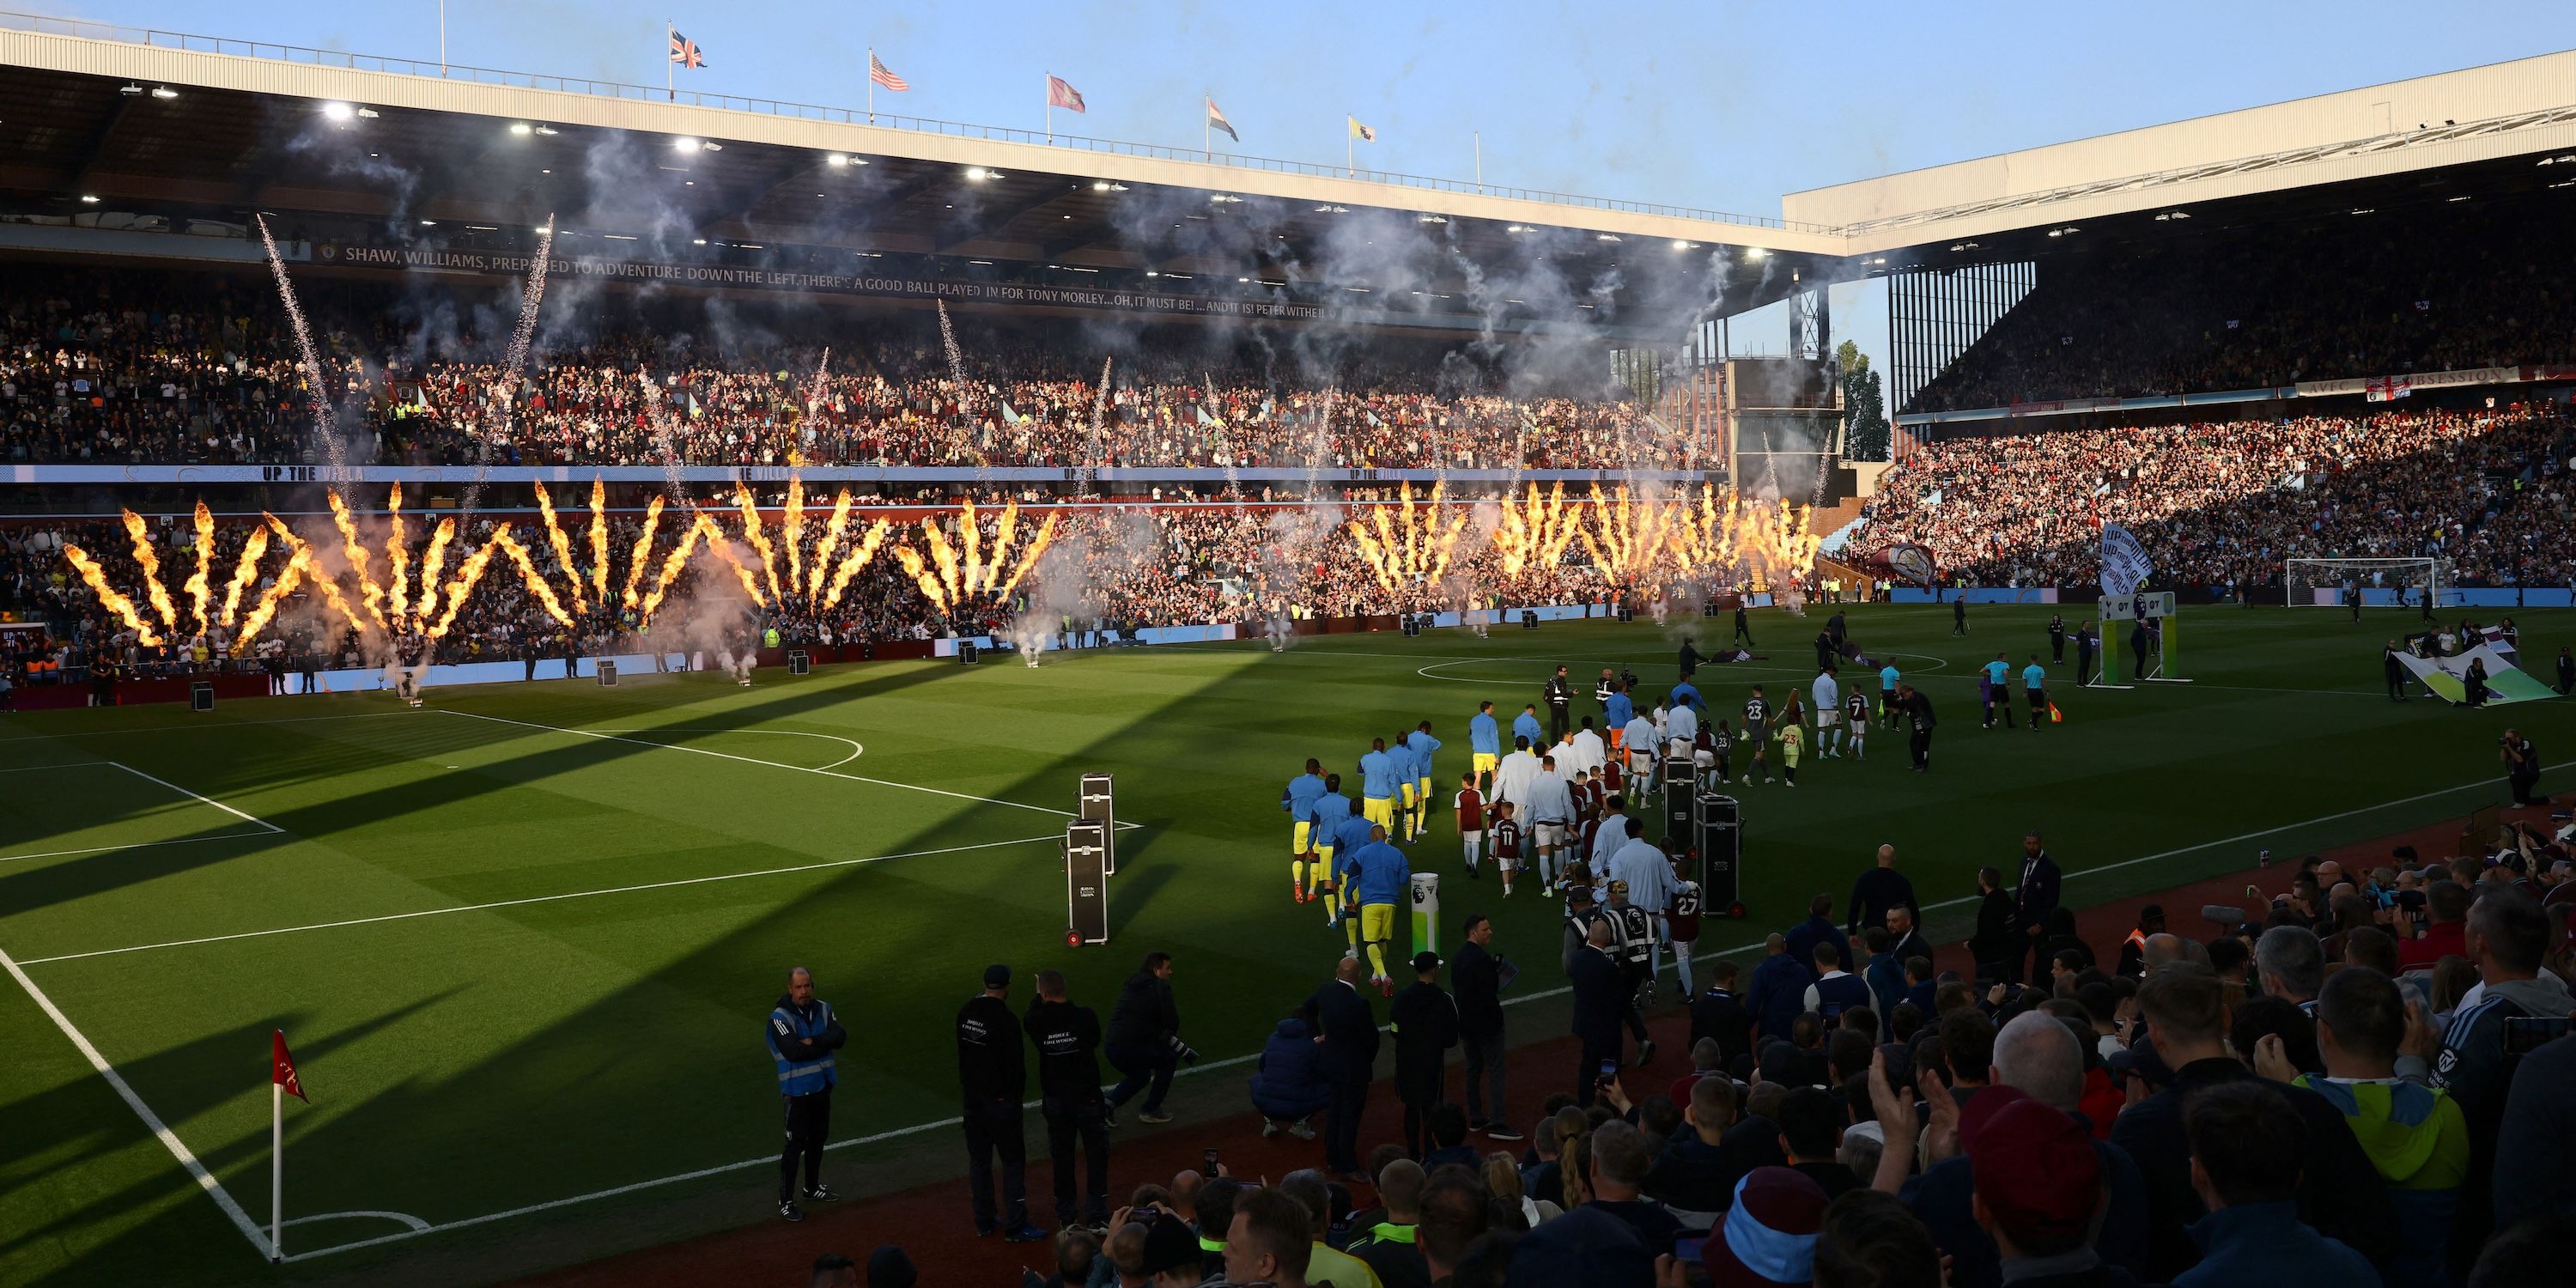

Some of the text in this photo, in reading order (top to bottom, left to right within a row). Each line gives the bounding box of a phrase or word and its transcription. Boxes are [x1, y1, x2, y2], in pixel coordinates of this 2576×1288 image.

[345, 246, 401, 265] SHAW,
[406, 250, 489, 270] WILLIAMS,
[492, 257, 568, 274] PREPED
[573, 261, 592, 275] TO
[596, 262, 682, 279] ADVENTURE
[687, 267, 733, 282] DOWN
[736, 270, 762, 283] THE
[854, 278, 864, 289] A
[865, 278, 902, 291] GOOD
[907, 282, 936, 294] BALL
[938, 283, 981, 296] PLAYED
[987, 286, 998, 297] IN
[1001, 287, 1024, 300] FOR
[1027, 289, 1059, 301] TONY
[1146, 297, 1176, 309] MUST
[1178, 299, 1194, 311] BE!
[1229, 302, 1238, 313] IT
[1256, 304, 1285, 317] PETER
[2310, 381, 2349, 393] AVFC
[263, 466, 282, 481] UP
[289, 466, 316, 481] THE
[1064, 468, 1076, 480] UP
[1350, 470, 1360, 480] UP
[1364, 470, 1377, 480] THE
[2107, 530, 2122, 541] UP
[2104, 544, 2117, 556] UP
[1747, 705, 1763, 720] 23
[1851, 702, 1861, 716] 7
[1717, 737, 1728, 747] 23
[1786, 734, 1796, 744] 23
[1503, 830, 1513, 846] 11
[1677, 896, 1698, 916] 27
[1637, 945, 1647, 954] 36
